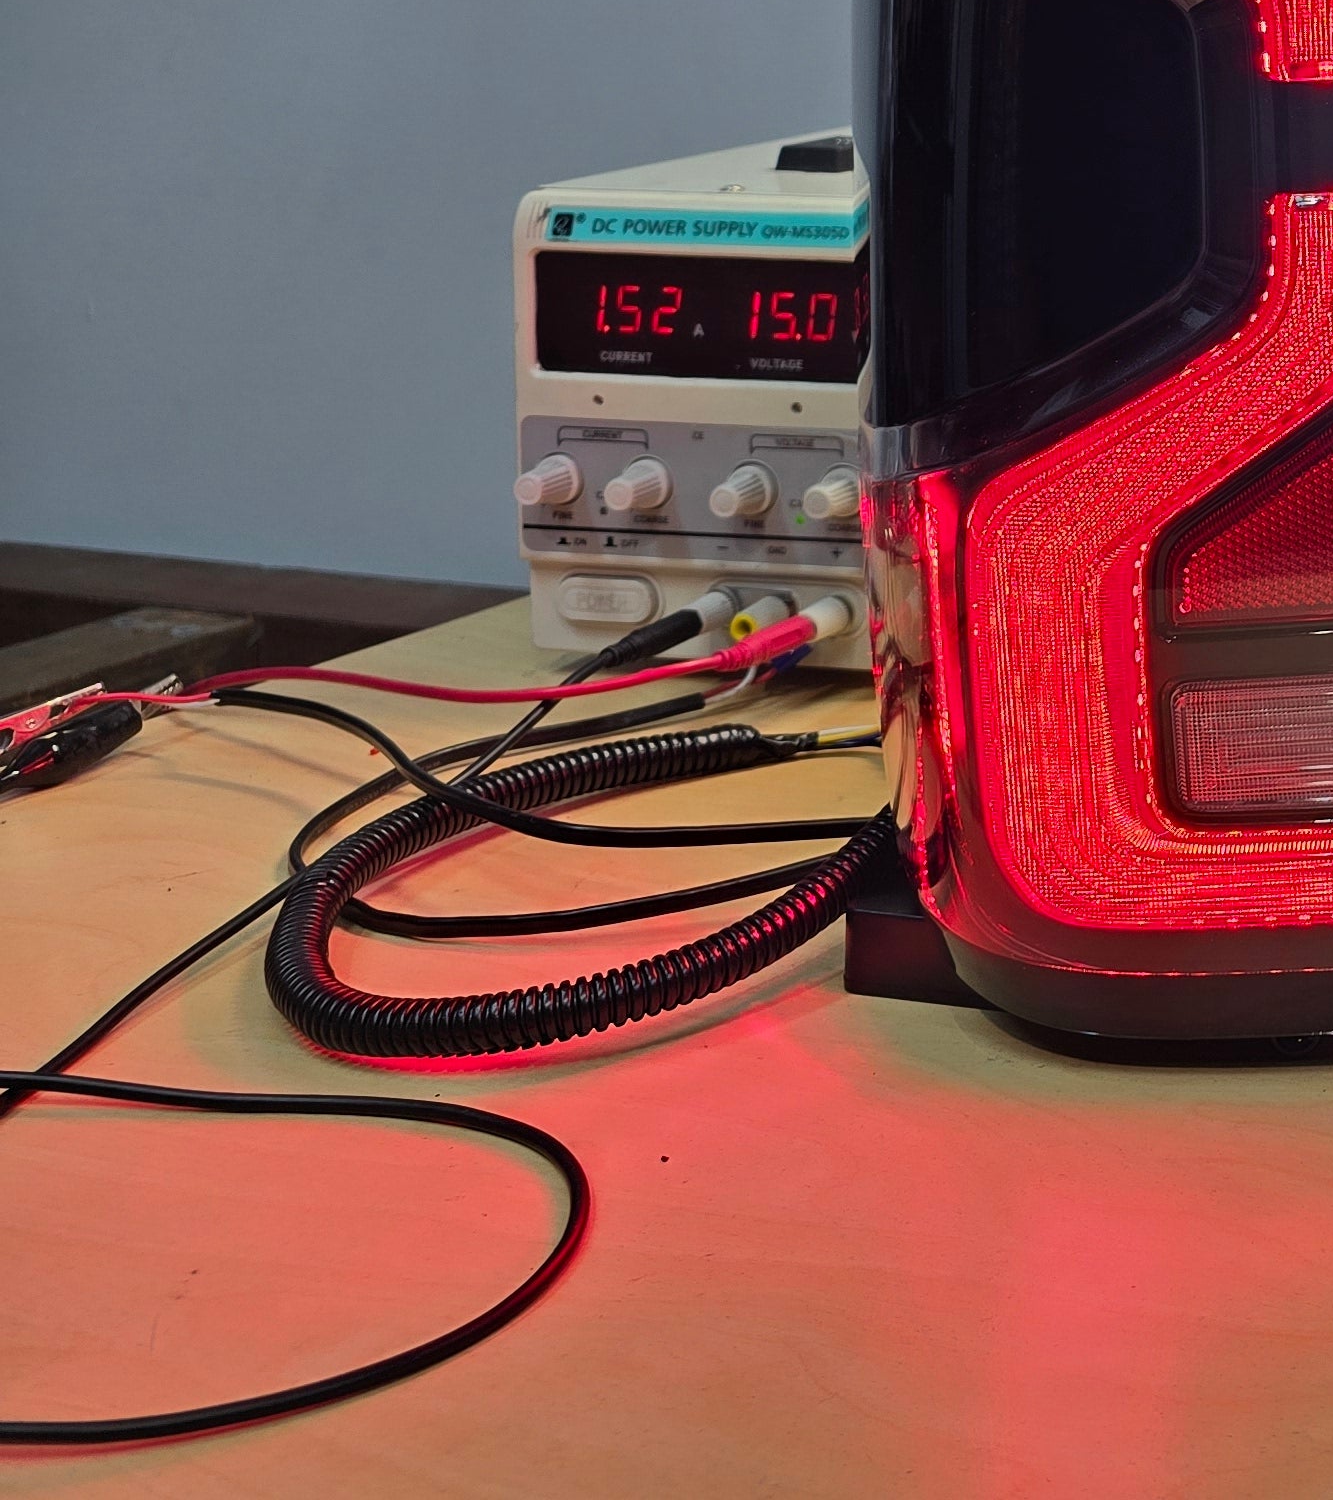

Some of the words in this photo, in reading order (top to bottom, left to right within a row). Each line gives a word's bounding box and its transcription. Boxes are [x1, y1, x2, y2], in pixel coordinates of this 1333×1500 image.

[592, 218, 618, 235] DC
[622, 218, 687, 237] POWER
[692, 220, 758, 238] SUPPLY
[596, 284, 683, 334] 1.52
[693, 323, 705, 337] A
[748, 290, 838, 342] 15.0
[600, 351, 653, 364] CURRENT
[750, 358, 804, 370] VOLTAGE
